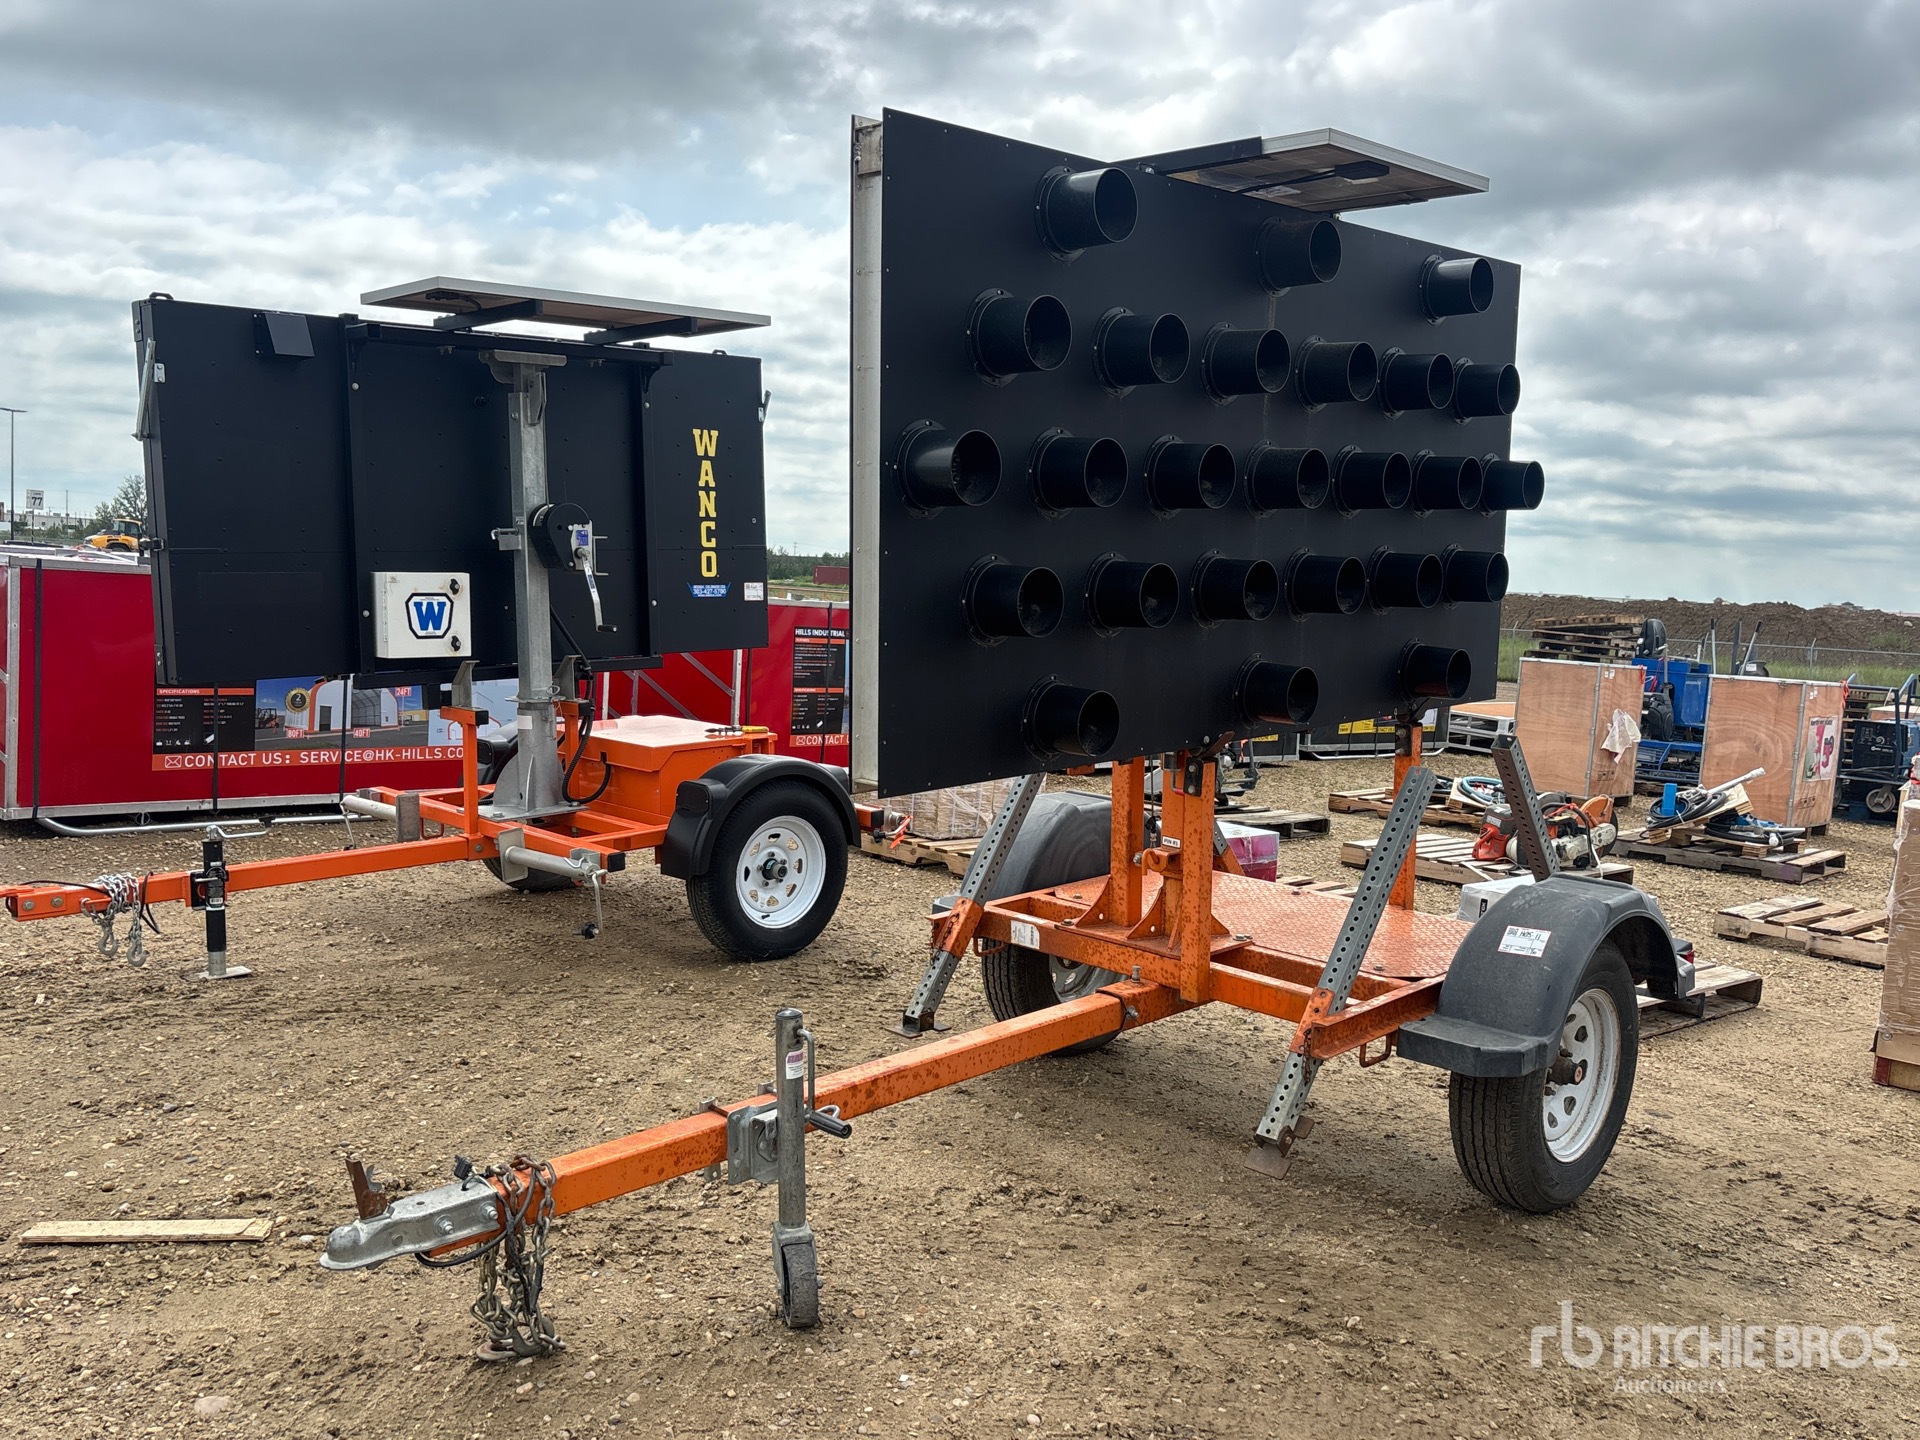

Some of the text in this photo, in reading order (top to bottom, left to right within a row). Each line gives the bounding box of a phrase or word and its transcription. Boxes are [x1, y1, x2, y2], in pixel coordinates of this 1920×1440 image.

[31, 497, 42, 506] 77
[693, 429, 718, 577] WANCO
[413, 601, 446, 631] W
[795, 628, 811, 636] HILLS
[396, 687, 411, 696] 24FT
[295, 693, 302, 701] 2
[287, 728, 303, 738] 80FT
[354, 728, 370, 737] 40FT
[806, 734, 844, 745] CONTACT
[185, 753, 257, 767] CONTACT
[262, 752, 290, 765] US:
